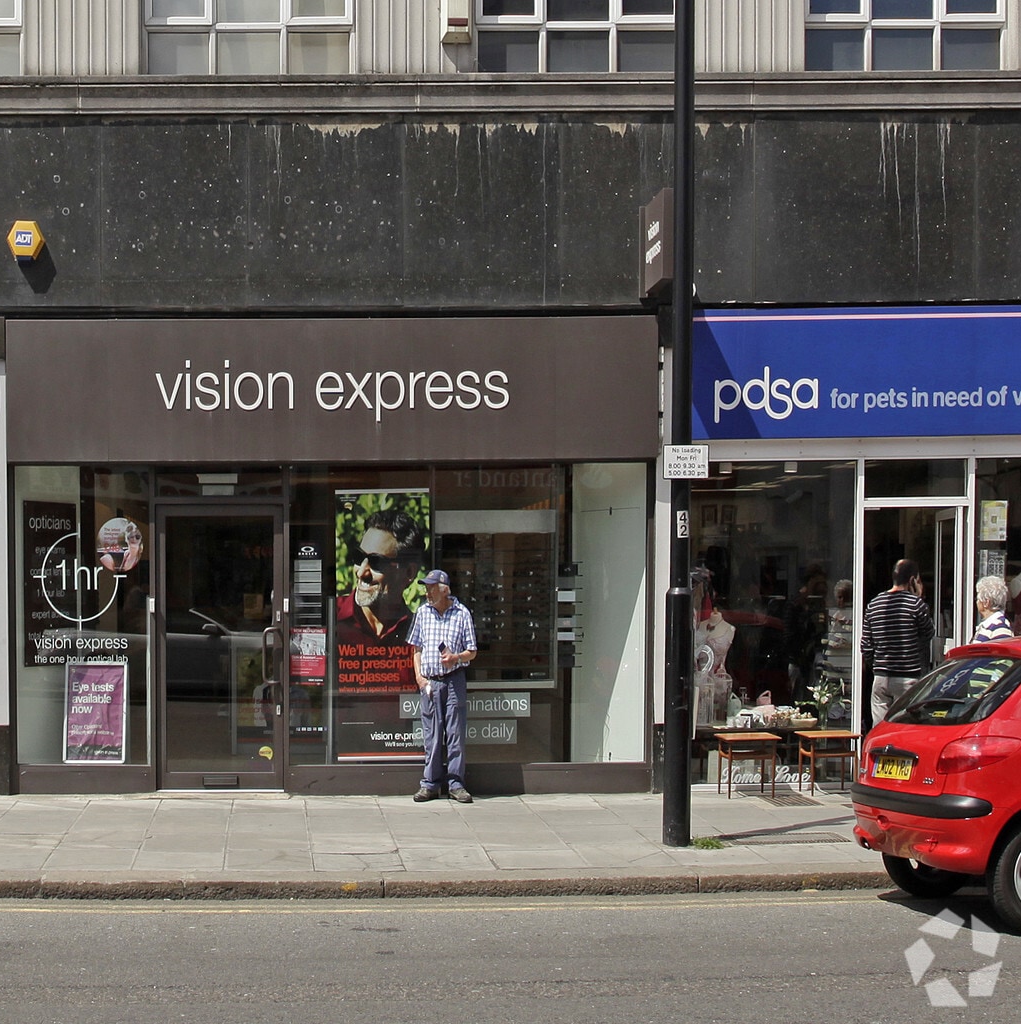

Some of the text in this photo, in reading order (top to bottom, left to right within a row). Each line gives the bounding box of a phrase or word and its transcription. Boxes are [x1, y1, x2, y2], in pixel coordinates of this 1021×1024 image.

[15, 233, 33, 244] ADT
[155, 359, 511, 423] vision express
[714, 366, 819, 424] pdsa
[830, 388, 860, 409] for
[864, 387, 909, 413] pets
[911, 387, 929, 408] in
[932, 387, 983, 407] need
[986, 385, 1009, 407] of
[29, 516, 71, 532] opticians
[35, 547, 46, 555] eye
[55, 558, 104, 590] 1hr
[42, 589, 55, 597] our
[32, 611, 51, 619] expert
[34, 635, 128, 652] vision express
[338, 644, 409, 657] We'll see you
[34, 655, 47, 664] the
[66, 655, 85, 664] hour
[87, 654, 114, 663] optical
[116, 655, 129, 664] lab
[338, 657, 413, 671] free prescripti
[338, 671, 400, 685] sunglasses
[72, 682, 115, 694] Eye tests
[71, 693, 112, 704] available
[71, 705, 93, 714] now
[402, 700, 420, 716] ey
[370, 731, 393, 741] vision
[481, 723, 514, 742] daily
